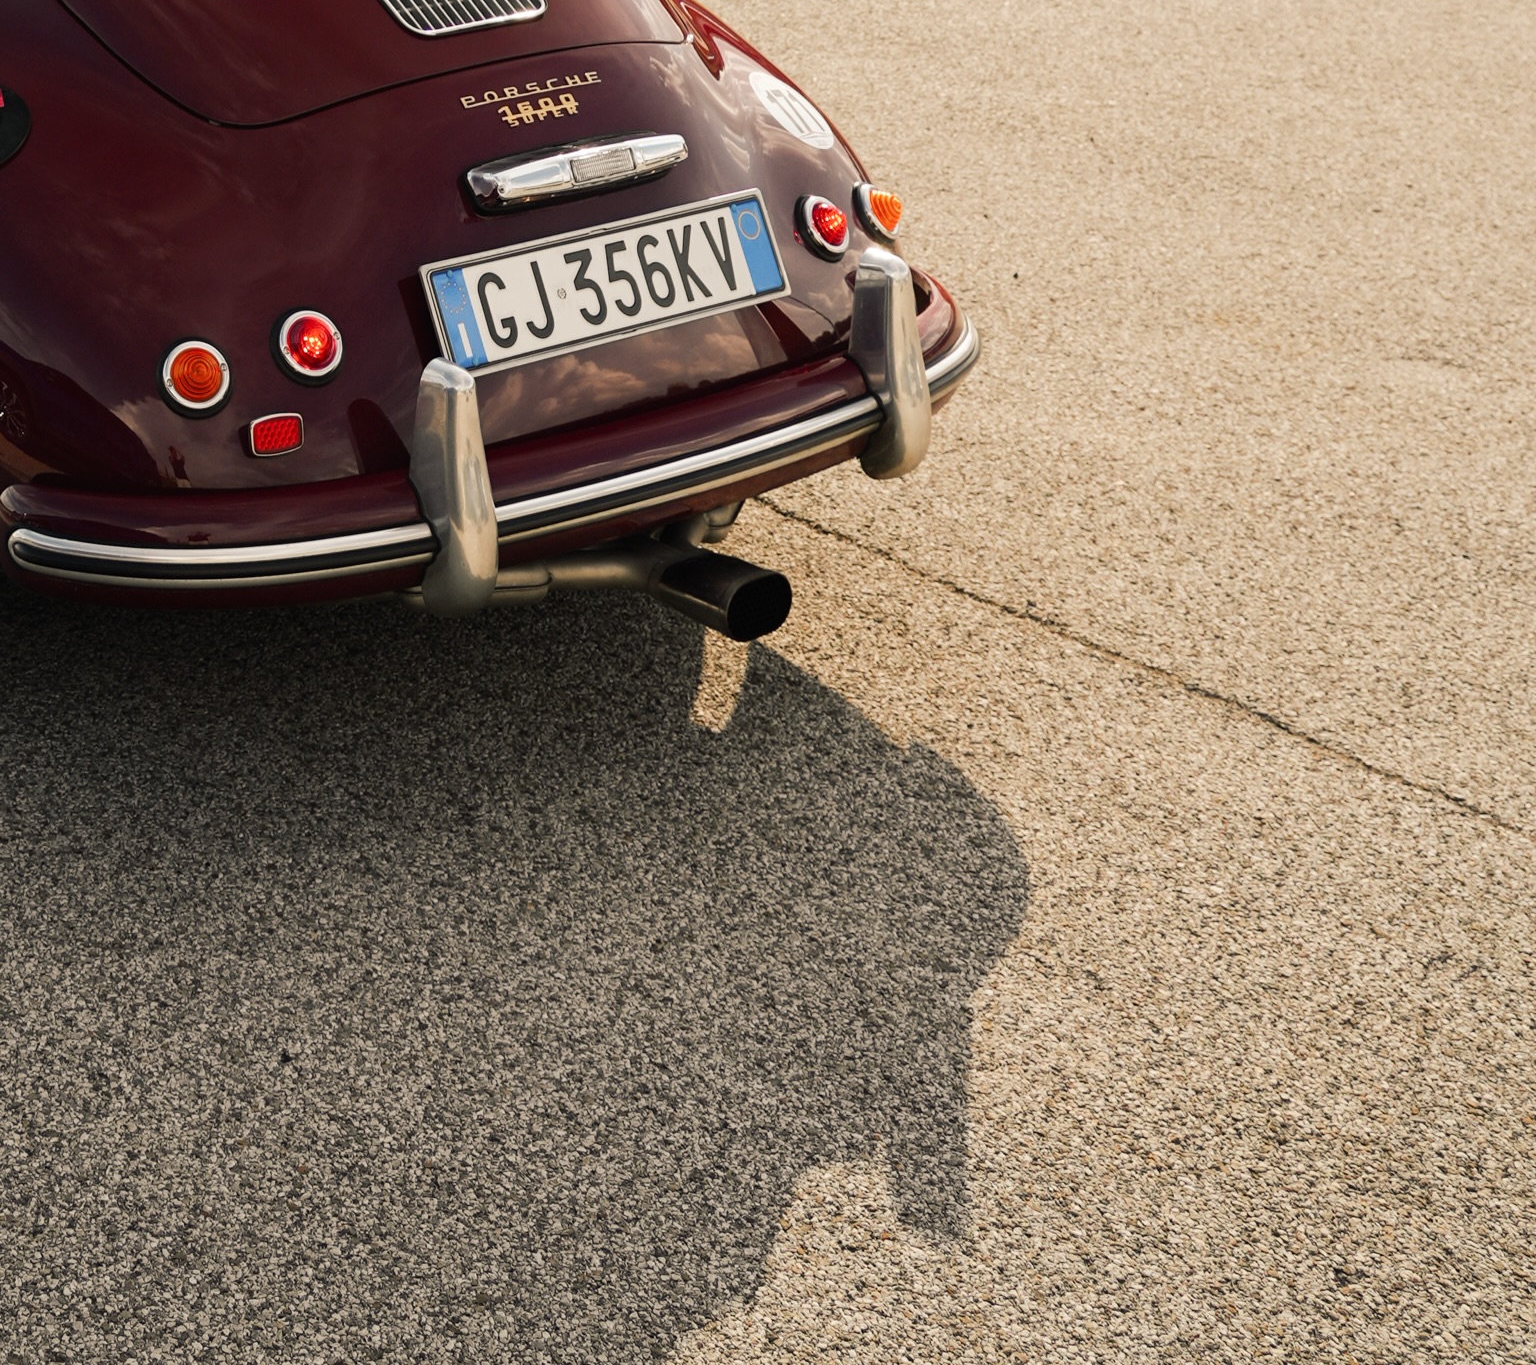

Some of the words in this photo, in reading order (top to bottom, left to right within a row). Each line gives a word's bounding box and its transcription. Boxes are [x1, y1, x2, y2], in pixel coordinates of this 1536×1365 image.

[460, 71, 602, 109] PORSCHE
[498, 93, 579, 121] 1600
[508, 104, 578, 128] SUPER
[765, 89, 826, 134] 171
[477, 261, 556, 349] GJ
[564, 216, 739, 326] 356KV
